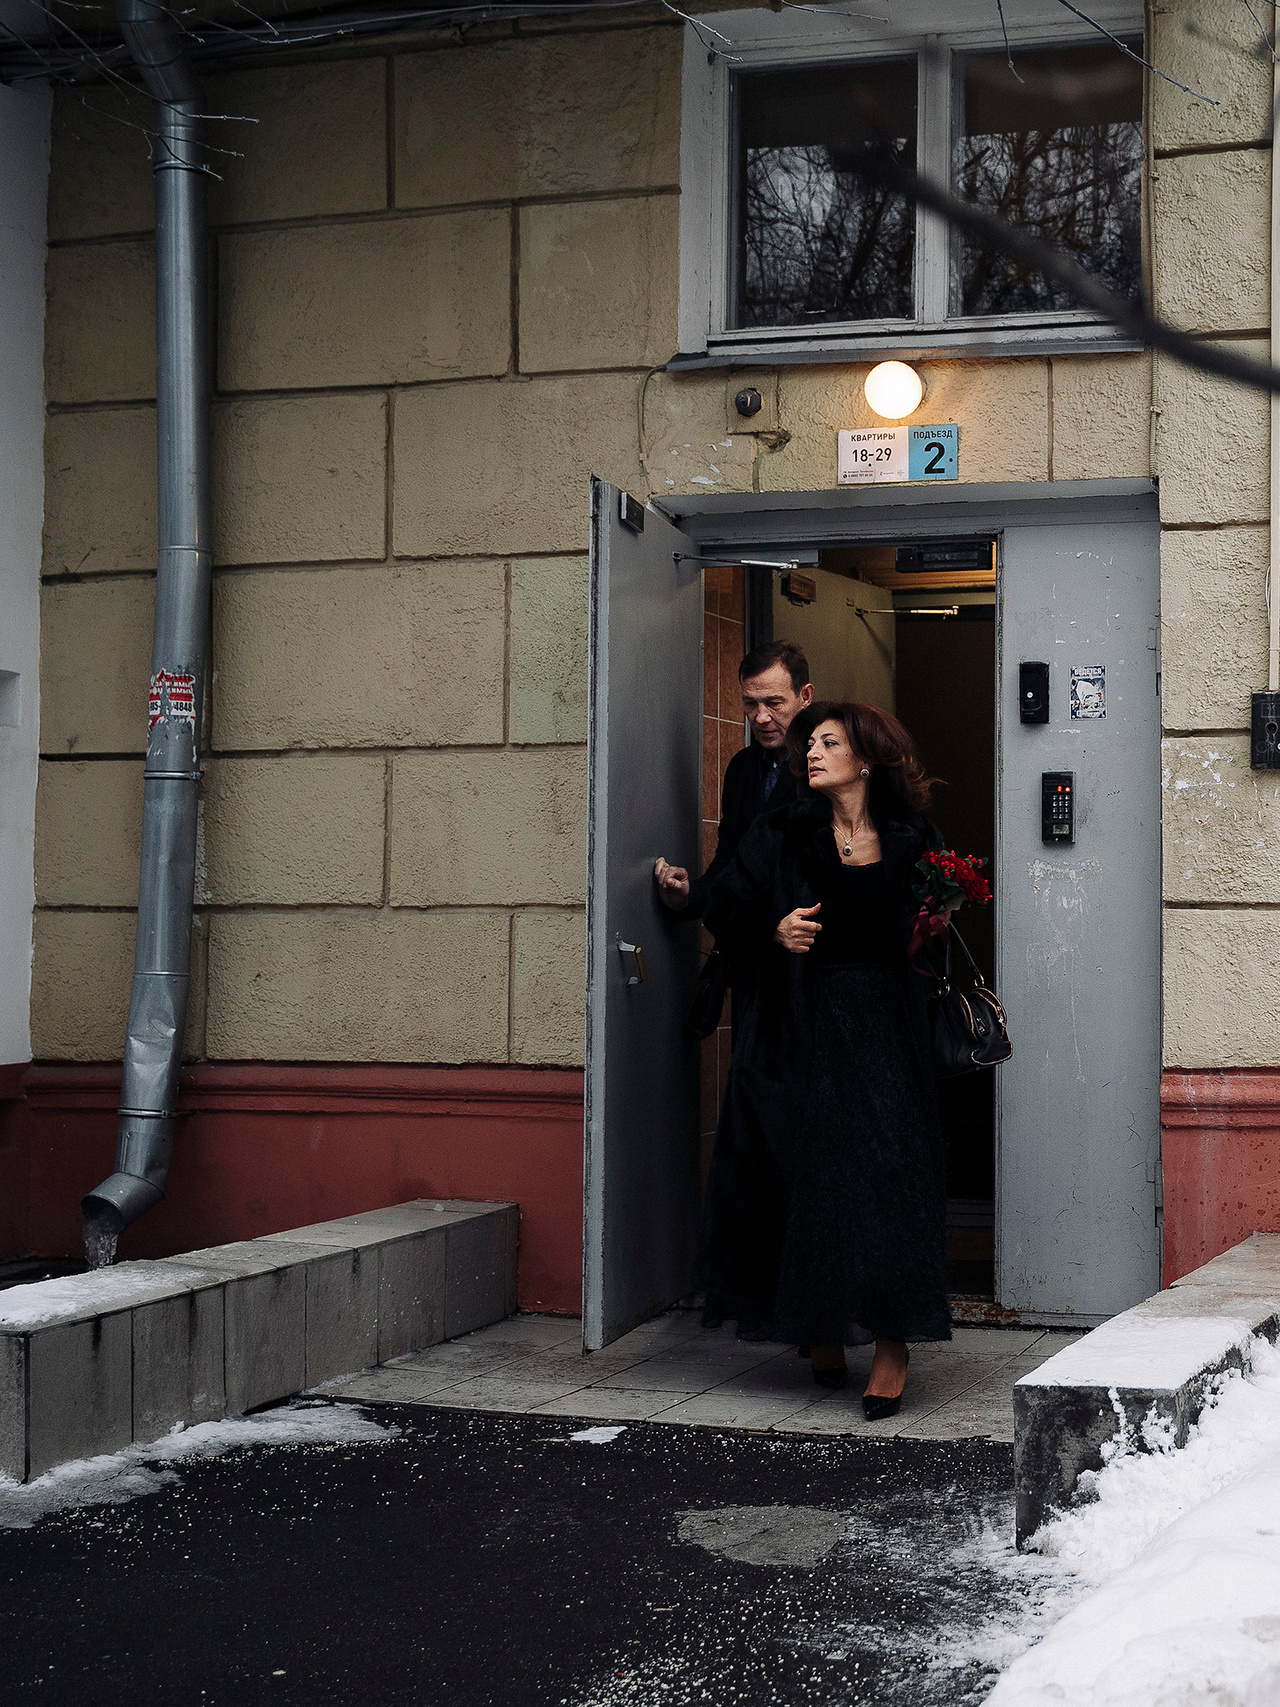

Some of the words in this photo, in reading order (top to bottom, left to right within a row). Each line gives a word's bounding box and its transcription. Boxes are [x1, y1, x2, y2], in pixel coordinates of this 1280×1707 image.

[851, 433, 896, 442] КВАРТИРЫ
[913, 430, 953, 440] ПОДЪЕЗД
[852, 448, 891, 462] 18-29
[924, 442, 945, 474] 2
